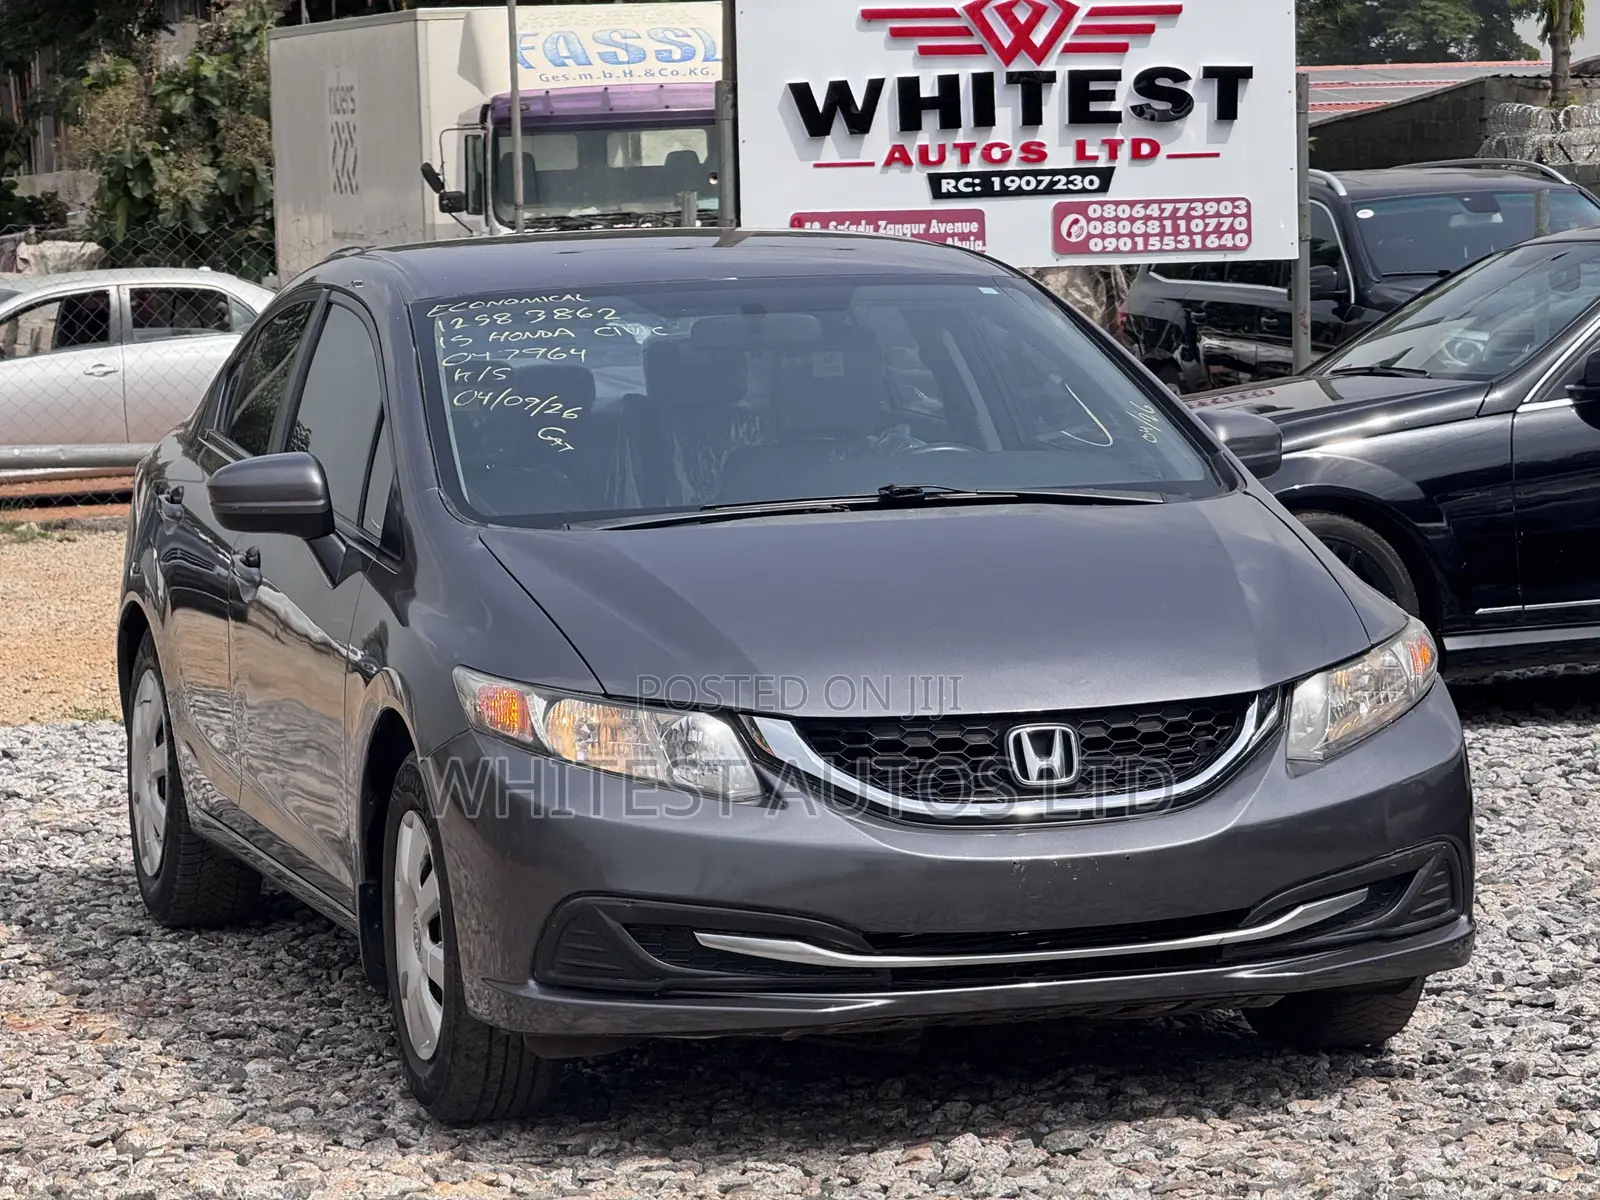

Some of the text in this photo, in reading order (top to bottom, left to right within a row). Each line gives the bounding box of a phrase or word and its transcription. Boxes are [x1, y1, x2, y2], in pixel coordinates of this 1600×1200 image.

[788, 65, 1253, 138] WHITEST
[882, 137, 1162, 168] AUTOS LTD
[940, 174, 1100, 194] RC: 1907230
[1087, 200, 1248, 218] 08064773903
[929, 219, 979, 233] Avenue
[1088, 216, 1248, 235] 08068110770
[1088, 232, 1249, 252] 09015531640
[426, 293, 591, 318] ECONOMICAL
[488, 327, 576, 343] HONDA
[453, 388, 583, 420] 04/09/26
